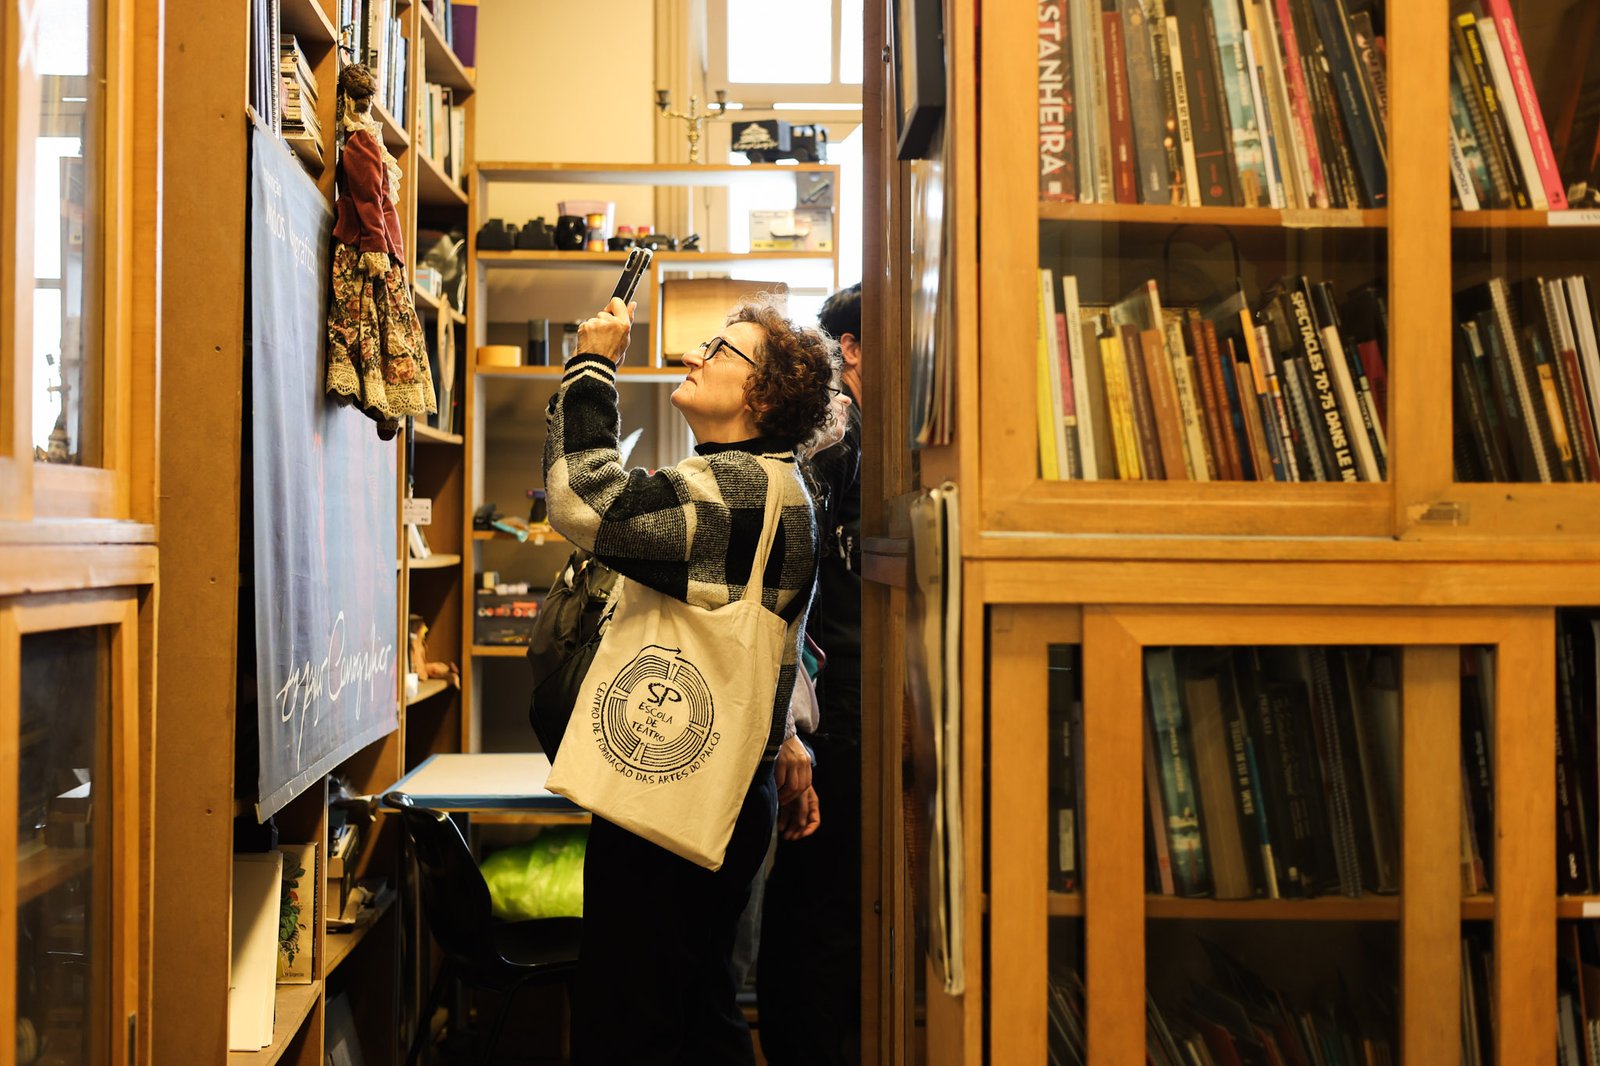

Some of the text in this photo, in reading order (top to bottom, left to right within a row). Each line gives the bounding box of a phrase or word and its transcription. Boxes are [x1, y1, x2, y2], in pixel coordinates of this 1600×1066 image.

[1038, 0, 1066, 175] STANHEIRA
[1175, 72, 1187, 103] AMERICAN
[1182, 120, 1190, 142] DESIGN
[1290, 291, 1323, 371] SPECTACLES
[1313, 374, 1333, 409] 70-75
[1323, 411, 1348, 448] DANS
[1336, 449, 1352, 466] LE
[638, 702, 673, 724] ESCOLA
[647, 682, 682, 707] SP
[591, 682, 721, 784] CENTRO DE FORMAÇÃO DAS ARTES DO PALCO
[632, 721, 665, 742] TEATRO
[646, 717, 657, 727] DE
